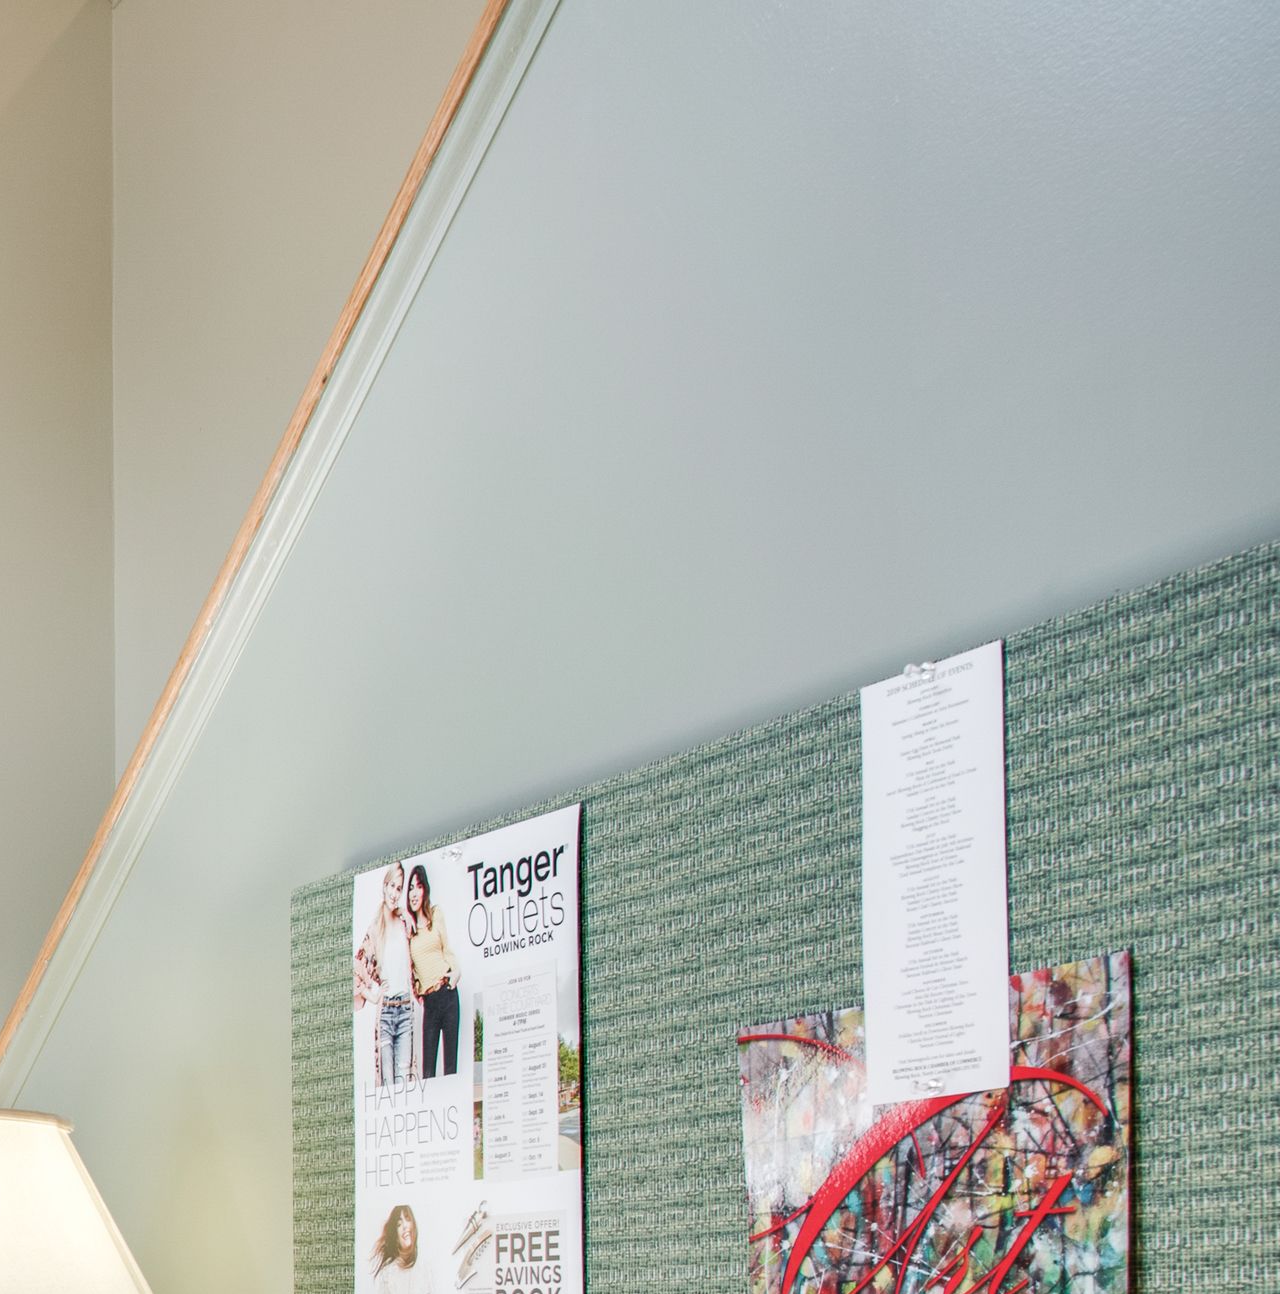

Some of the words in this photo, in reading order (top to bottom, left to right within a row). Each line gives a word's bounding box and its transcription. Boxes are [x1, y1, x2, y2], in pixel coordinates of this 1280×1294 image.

[468, 846, 564, 900] Tanger
[468, 886, 564, 947] Outlets
[484, 939, 526, 958] BLOWING
[529, 930, 554, 946] ROCK
[364, 1072, 427, 1112] HAPPY
[365, 1106, 458, 1150] HAPPENS
[365, 1152, 415, 1188] HERE
[496, 1221, 533, 1232] EXCLUSIVE
[535, 1219, 560, 1229] OFFER!
[495, 1231, 561, 1264] FREE
[495, 1265, 561, 1286] SAVINGS
